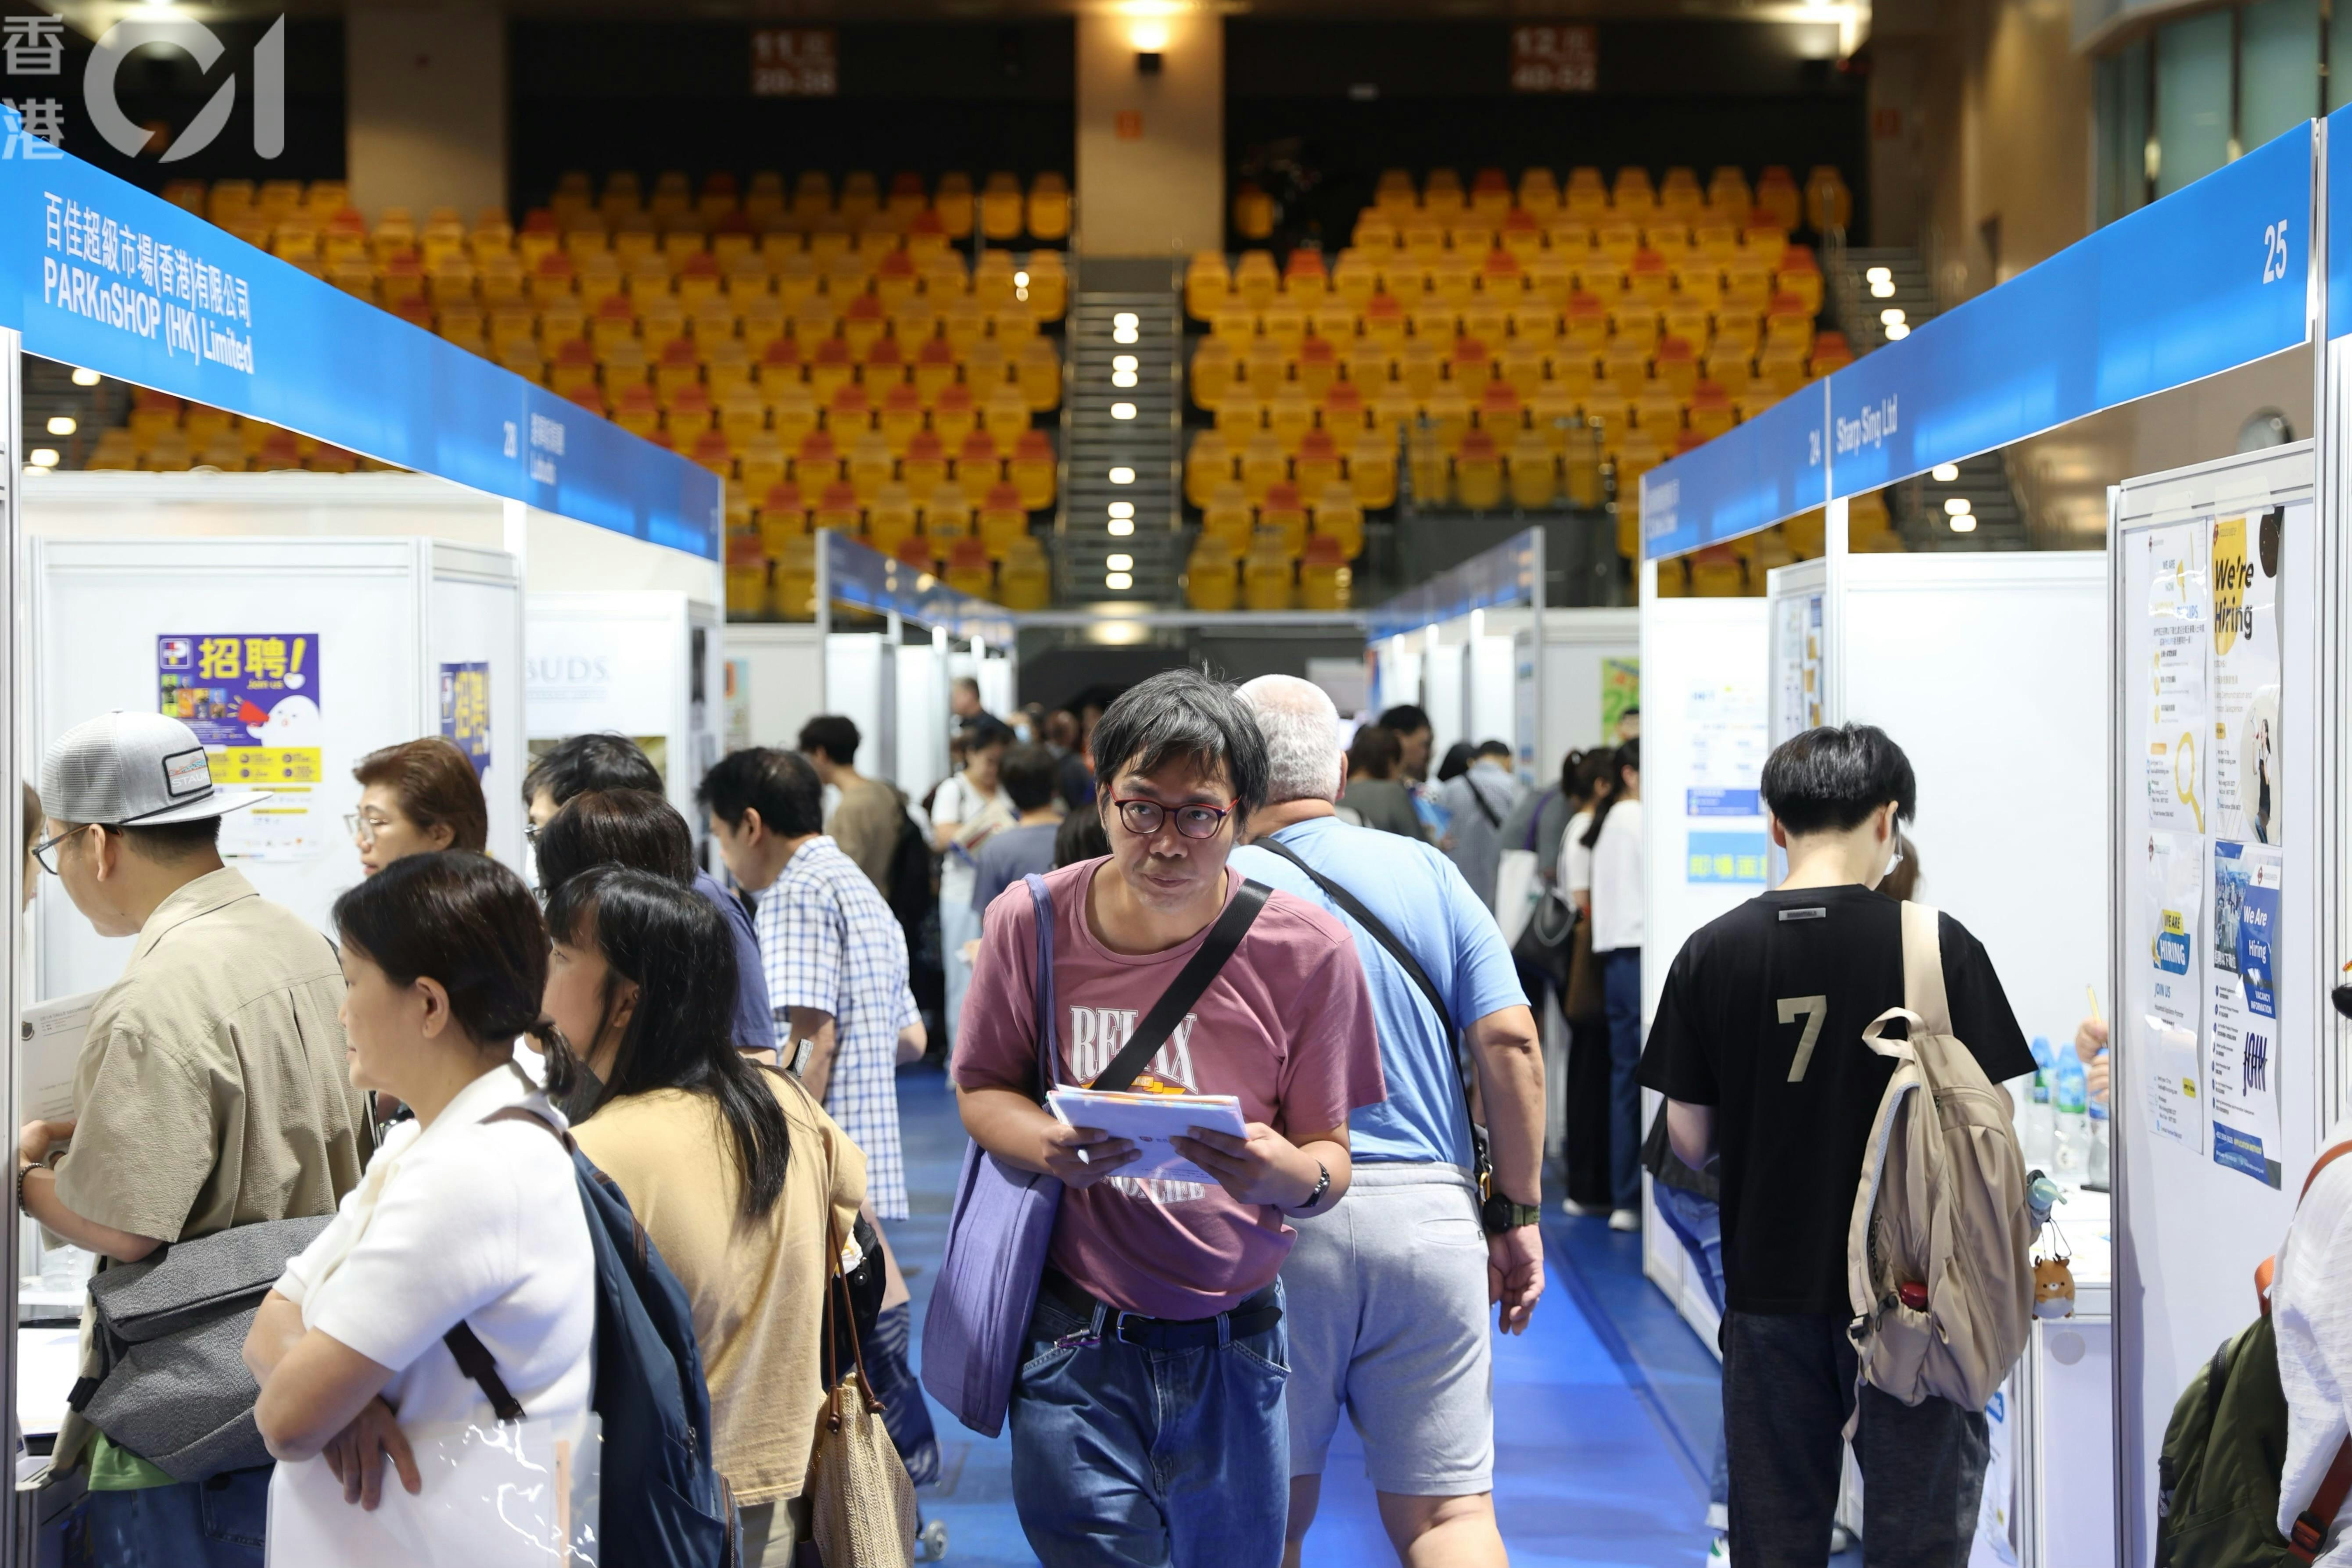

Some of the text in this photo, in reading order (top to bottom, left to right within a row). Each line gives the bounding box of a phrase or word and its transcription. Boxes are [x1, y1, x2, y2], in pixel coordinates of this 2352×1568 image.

[44, 191, 252, 328] 百佳超級市場(香港)有限公司
[2263, 219, 2287, 284] 25
[44, 256, 254, 374] PARKnSHOP (HK) Limited
[1836, 416, 1861, 457] Sharp
[1882, 393, 1898, 436] Ltd
[2216, 555, 2254, 591] We're
[2215, 595, 2253, 641] Hiring
[198, 637, 307, 680] 招聘!
[2172, 916, 2180, 929] ARE
[2243, 905, 2267, 927] We Are
[2160, 939, 2186, 966] HIRING
[2248, 939, 2267, 964] Hiring
[2154, 982, 2171, 998] JOIN US
[2250, 1000, 2272, 1015] INFORMATION
[2255, 990, 2270, 1003] VACANCY
[1777, 995, 1827, 1082] 7
